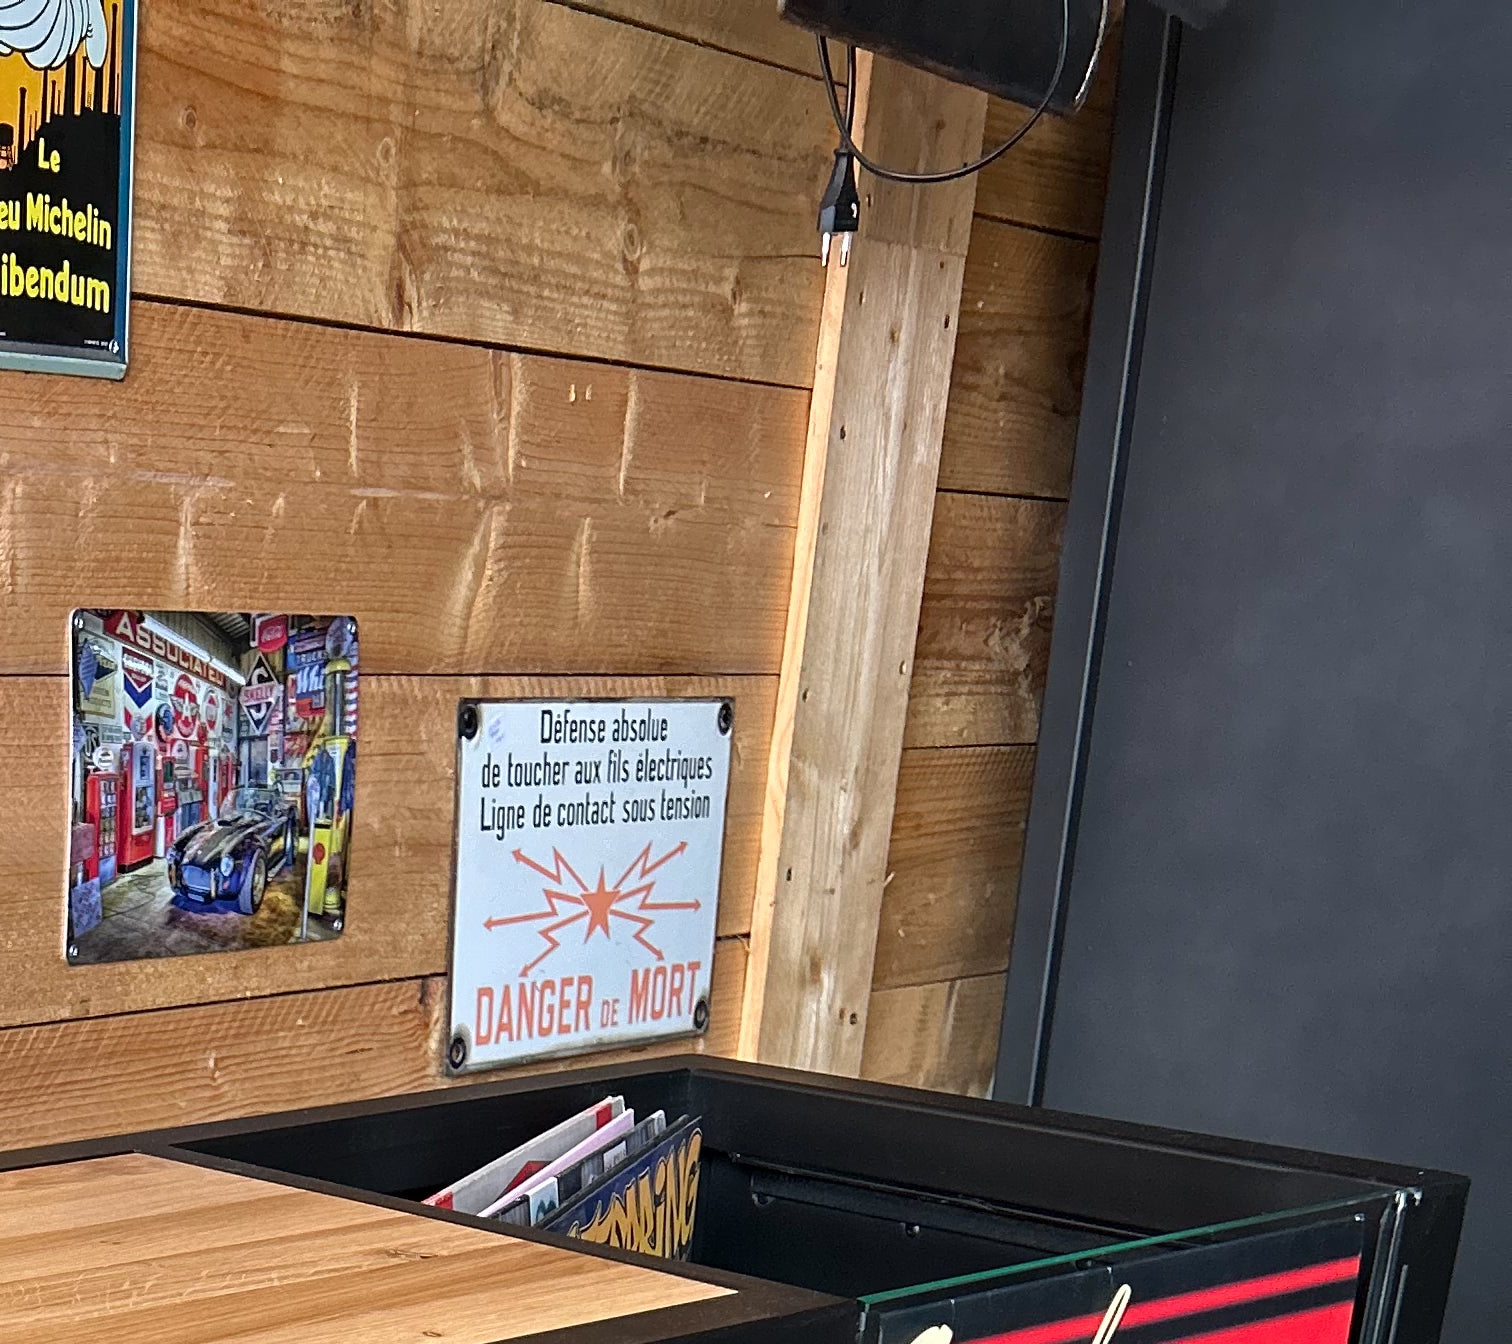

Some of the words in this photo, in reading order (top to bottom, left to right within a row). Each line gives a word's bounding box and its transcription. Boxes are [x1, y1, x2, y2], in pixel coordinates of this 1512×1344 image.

[38, 137, 61, 173] Le
[26, 192, 112, 250] Michelin
[540, 709, 605, 744] Défense
[612, 708, 668, 742] absolue
[481, 752, 500, 788] de
[507, 752, 569, 787] toucher
[574, 759, 601, 785] aux
[606, 750, 629, 783] fils
[636, 750, 713, 789] électriques
[480, 796, 525, 841] Ligne
[532, 795, 551, 827] de
[557, 791, 615, 826] contact
[622, 798, 655, 823] sous
[660, 789, 711, 822] tension
[475, 974, 593, 1046] DANGER
[600, 998, 620, 1028] DE
[627, 961, 701, 1026] MORT
